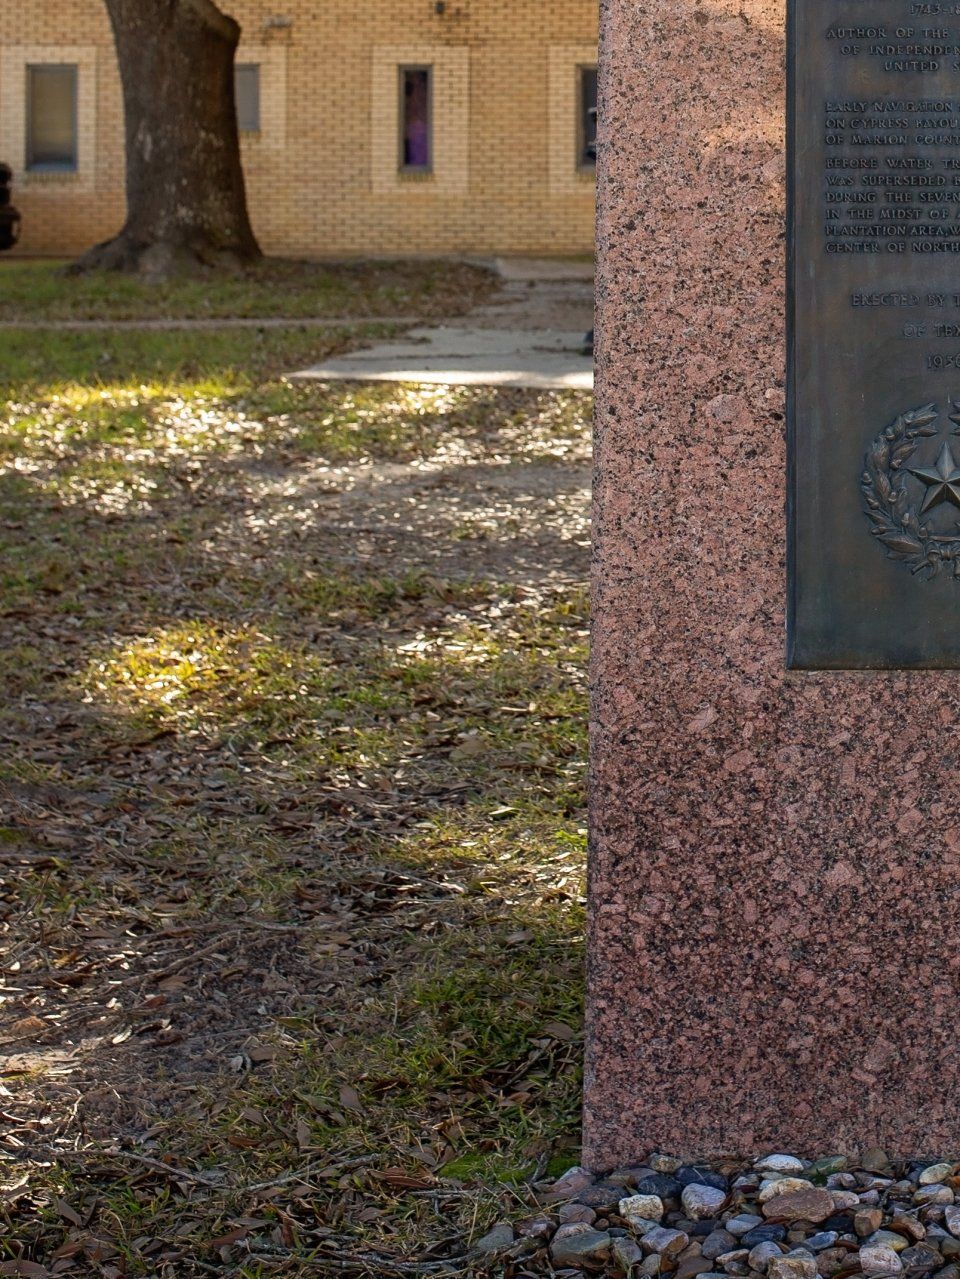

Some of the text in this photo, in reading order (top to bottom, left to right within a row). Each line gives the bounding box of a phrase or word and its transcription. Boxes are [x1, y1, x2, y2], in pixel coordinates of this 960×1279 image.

[825, 27, 888, 39] AUTHOR
[895, 27, 914, 39] OF
[923, 27, 949, 39] THE
[841, 45, 860, 56] OF
[884, 61, 939, 72] UNITED
[825, 101, 867, 113] EARLY
[874, 101, 953, 113] NAVIGATION
[825, 118, 845, 130] ON
[850, 118, 909, 130] CYPRESS
[825, 134, 844, 145] OF
[851, 134, 908, 145] MARION
[825, 159, 877, 170] BEFORE
[886, 159, 933, 170] WATER
[825, 176, 854, 187] WAS
[861, 176, 946, 187] SUPERSEDED
[825, 192, 876, 203] DURING
[886, 192, 912, 203] THE
[825, 209, 840, 220] IN
[848, 209, 874, 220] THE
[879, 209, 921, 220] MIDST
[929, 209, 949, 220] OF
[825, 225, 906, 237] PLANTATION
[825, 242, 880, 253] CENTER
[887, 242, 905, 253] OF
[851, 294, 920, 307] ERECTED
[927, 294, 945, 307] BY
[903, 325, 926, 338] OF
